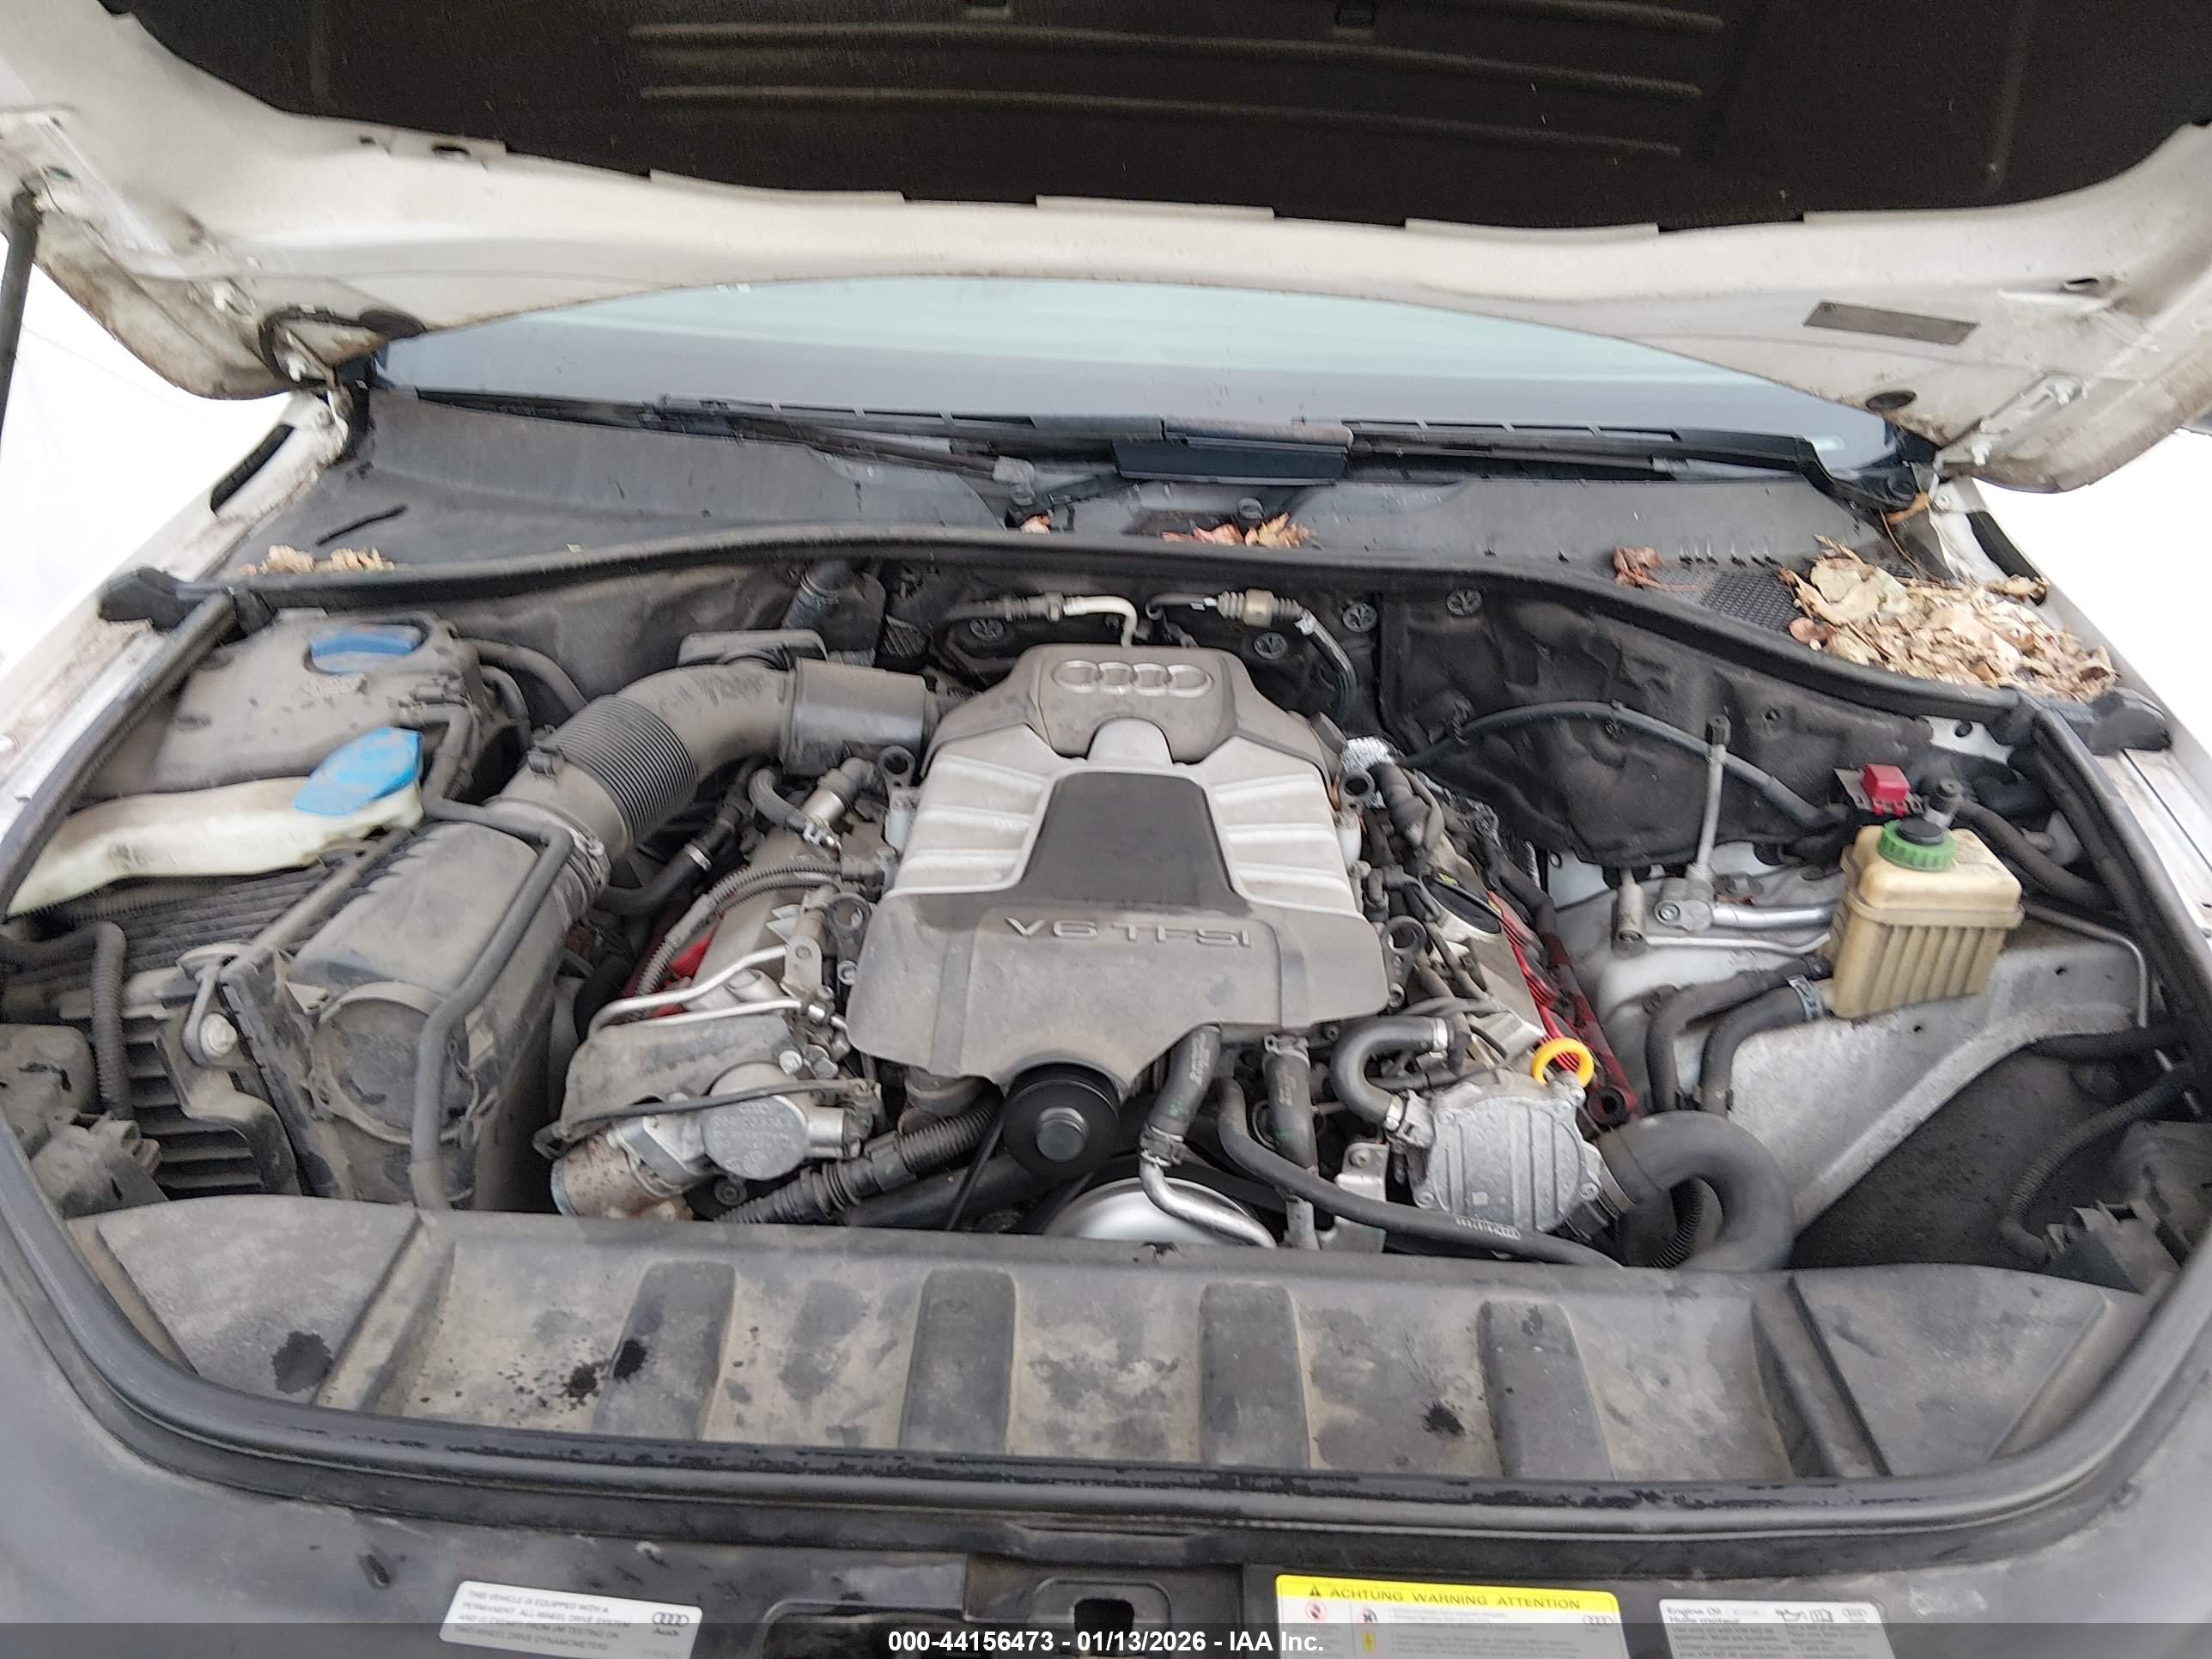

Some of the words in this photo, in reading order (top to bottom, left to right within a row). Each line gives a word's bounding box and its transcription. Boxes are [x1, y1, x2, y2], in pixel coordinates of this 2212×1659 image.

[1004, 916, 1098, 938] V6
[1111, 921, 1251, 949] TFSI
[535, 1599, 577, 1609] EQUIPPED
[579, 1603, 600, 1613] WITH
[1329, 1588, 1404, 1602] ACHTUNG
[1411, 1592, 1489, 1606] WARNING
[1497, 1595, 1581, 1610] ATTENTION
[1667, 1607, 1705, 1616] Engine
[1706, 1607, 1722, 1615] Oil
[653, 1627, 680, 1637] Audi
